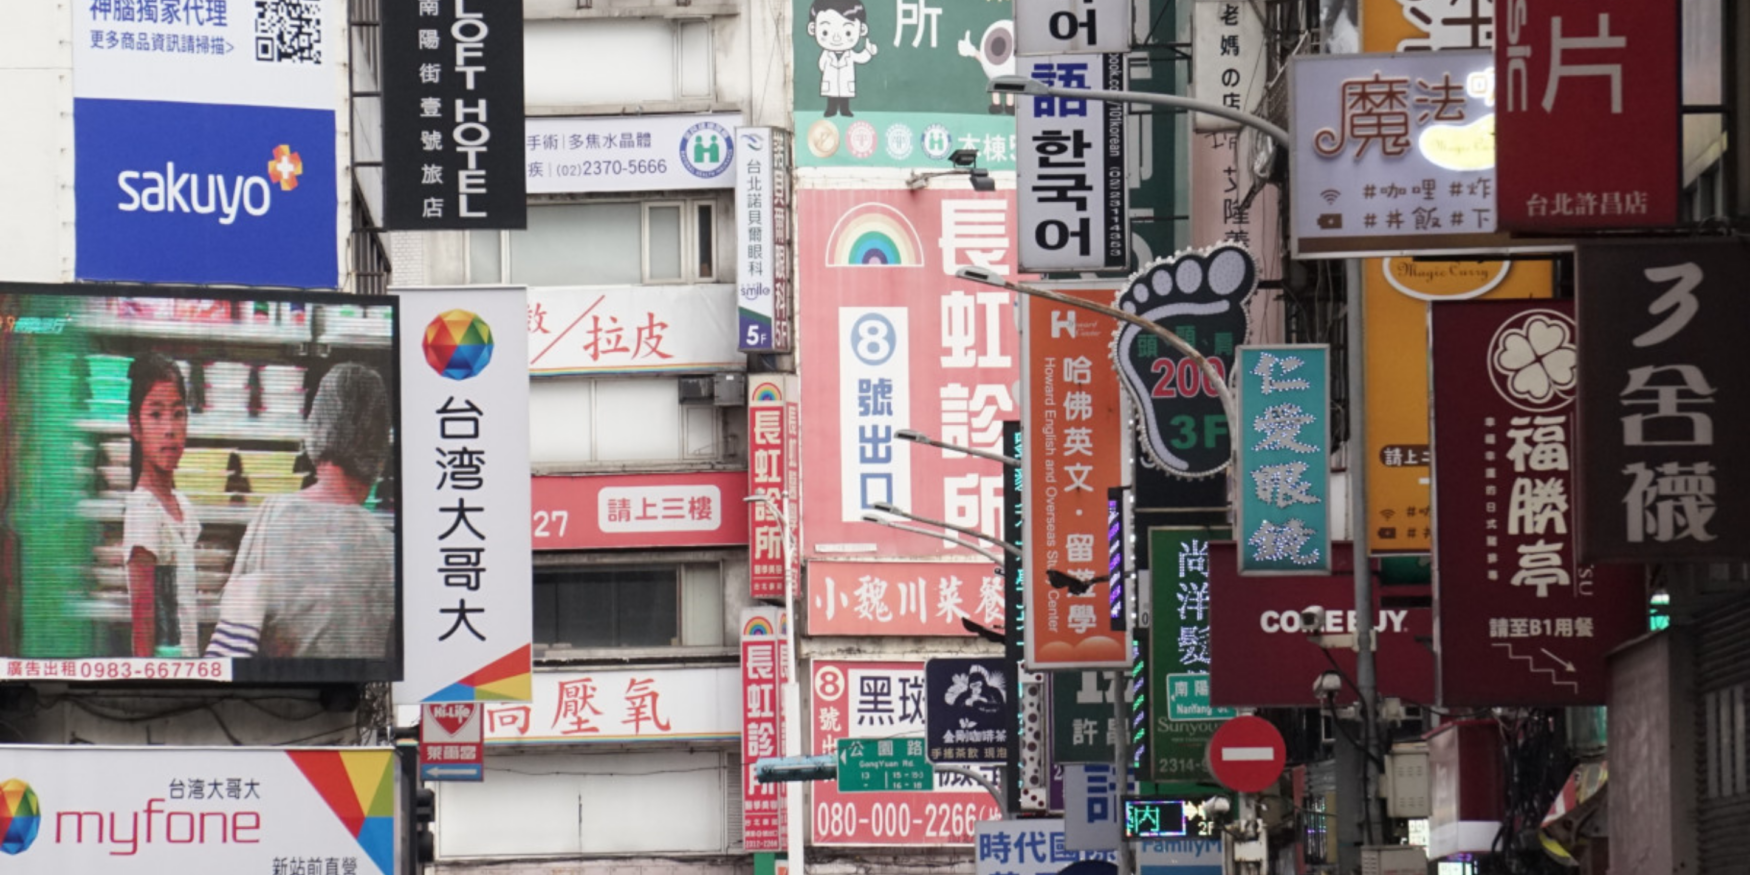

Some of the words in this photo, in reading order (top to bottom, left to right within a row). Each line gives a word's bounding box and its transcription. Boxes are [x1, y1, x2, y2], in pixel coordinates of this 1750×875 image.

[89, 0, 228, 27] 神腦獨家代理
[451, 0, 489, 91] LOFT
[1541, 13, 1627, 113] 片
[452, 99, 490, 218] HOTEL
[556, 159, 667, 178] (02)2370-5666
[118, 161, 271, 225] sakuyo
[1031, 129, 1094, 256] 한국어
[1526, 191, 1649, 216] 台北許昌店
[746, 159, 764, 277] 台北諾貝爾眼科
[1397, 262, 1448, 284] Magic
[1044, 358, 1057, 406] Howard
[1042, 409, 1057, 456] English
[1169, 414, 1230, 450] 3F
[753, 410, 781, 560] 長虹診所
[1044, 459, 1058, 483] and
[606, 497, 713, 523] 請上三樓
[1045, 486, 1058, 547] Overseas
[1505, 414, 1571, 598] 福勝亭
[1047, 590, 1060, 633] Center
[1176, 539, 1212, 676] 尚洋髮
[1489, 617, 1594, 638] 請至B1用餐
[7, 661, 77, 678] 廣告出租
[81, 661, 223, 682] 0983-667768
[849, 740, 923, 757] 公園路
[1156, 716, 1218, 736] Sunyou
[55, 798, 261, 856] myfone
